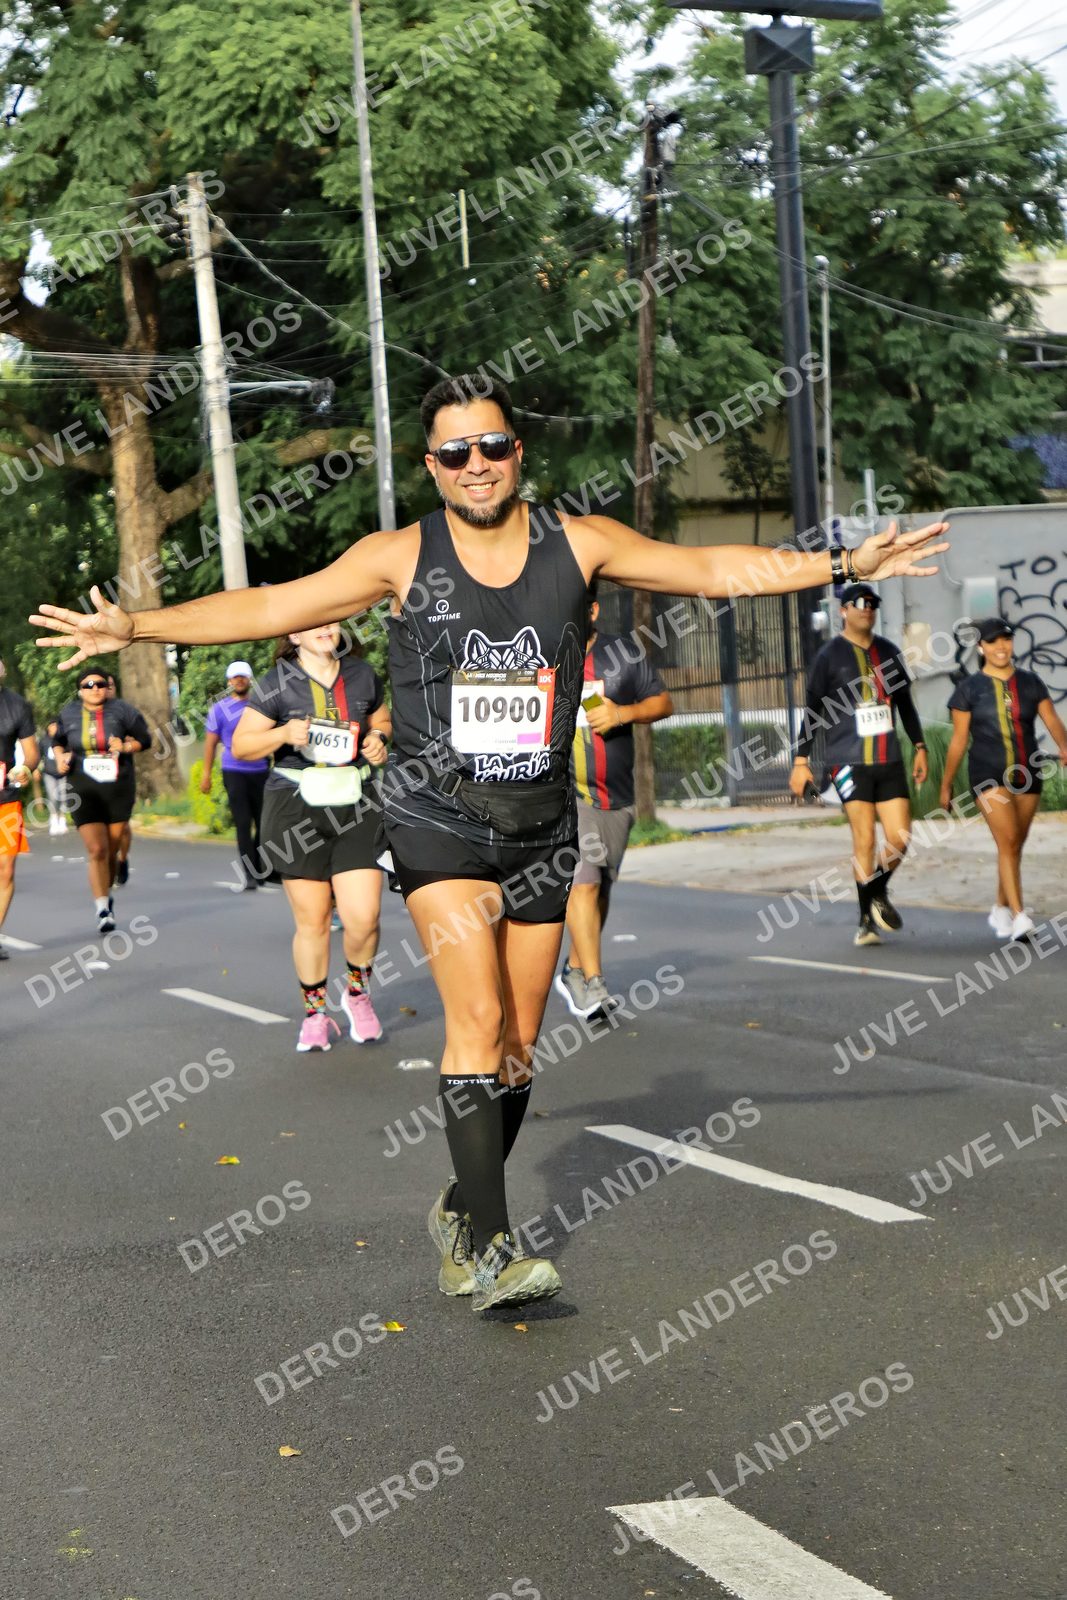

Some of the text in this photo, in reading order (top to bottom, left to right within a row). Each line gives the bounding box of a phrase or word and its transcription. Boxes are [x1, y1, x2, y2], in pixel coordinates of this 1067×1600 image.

[999, 551, 1067, 580] TO
[427, 612, 461, 623] TOPTIME
[458, 696, 541, 723] 10900
[308, 730, 349, 749] 10651
